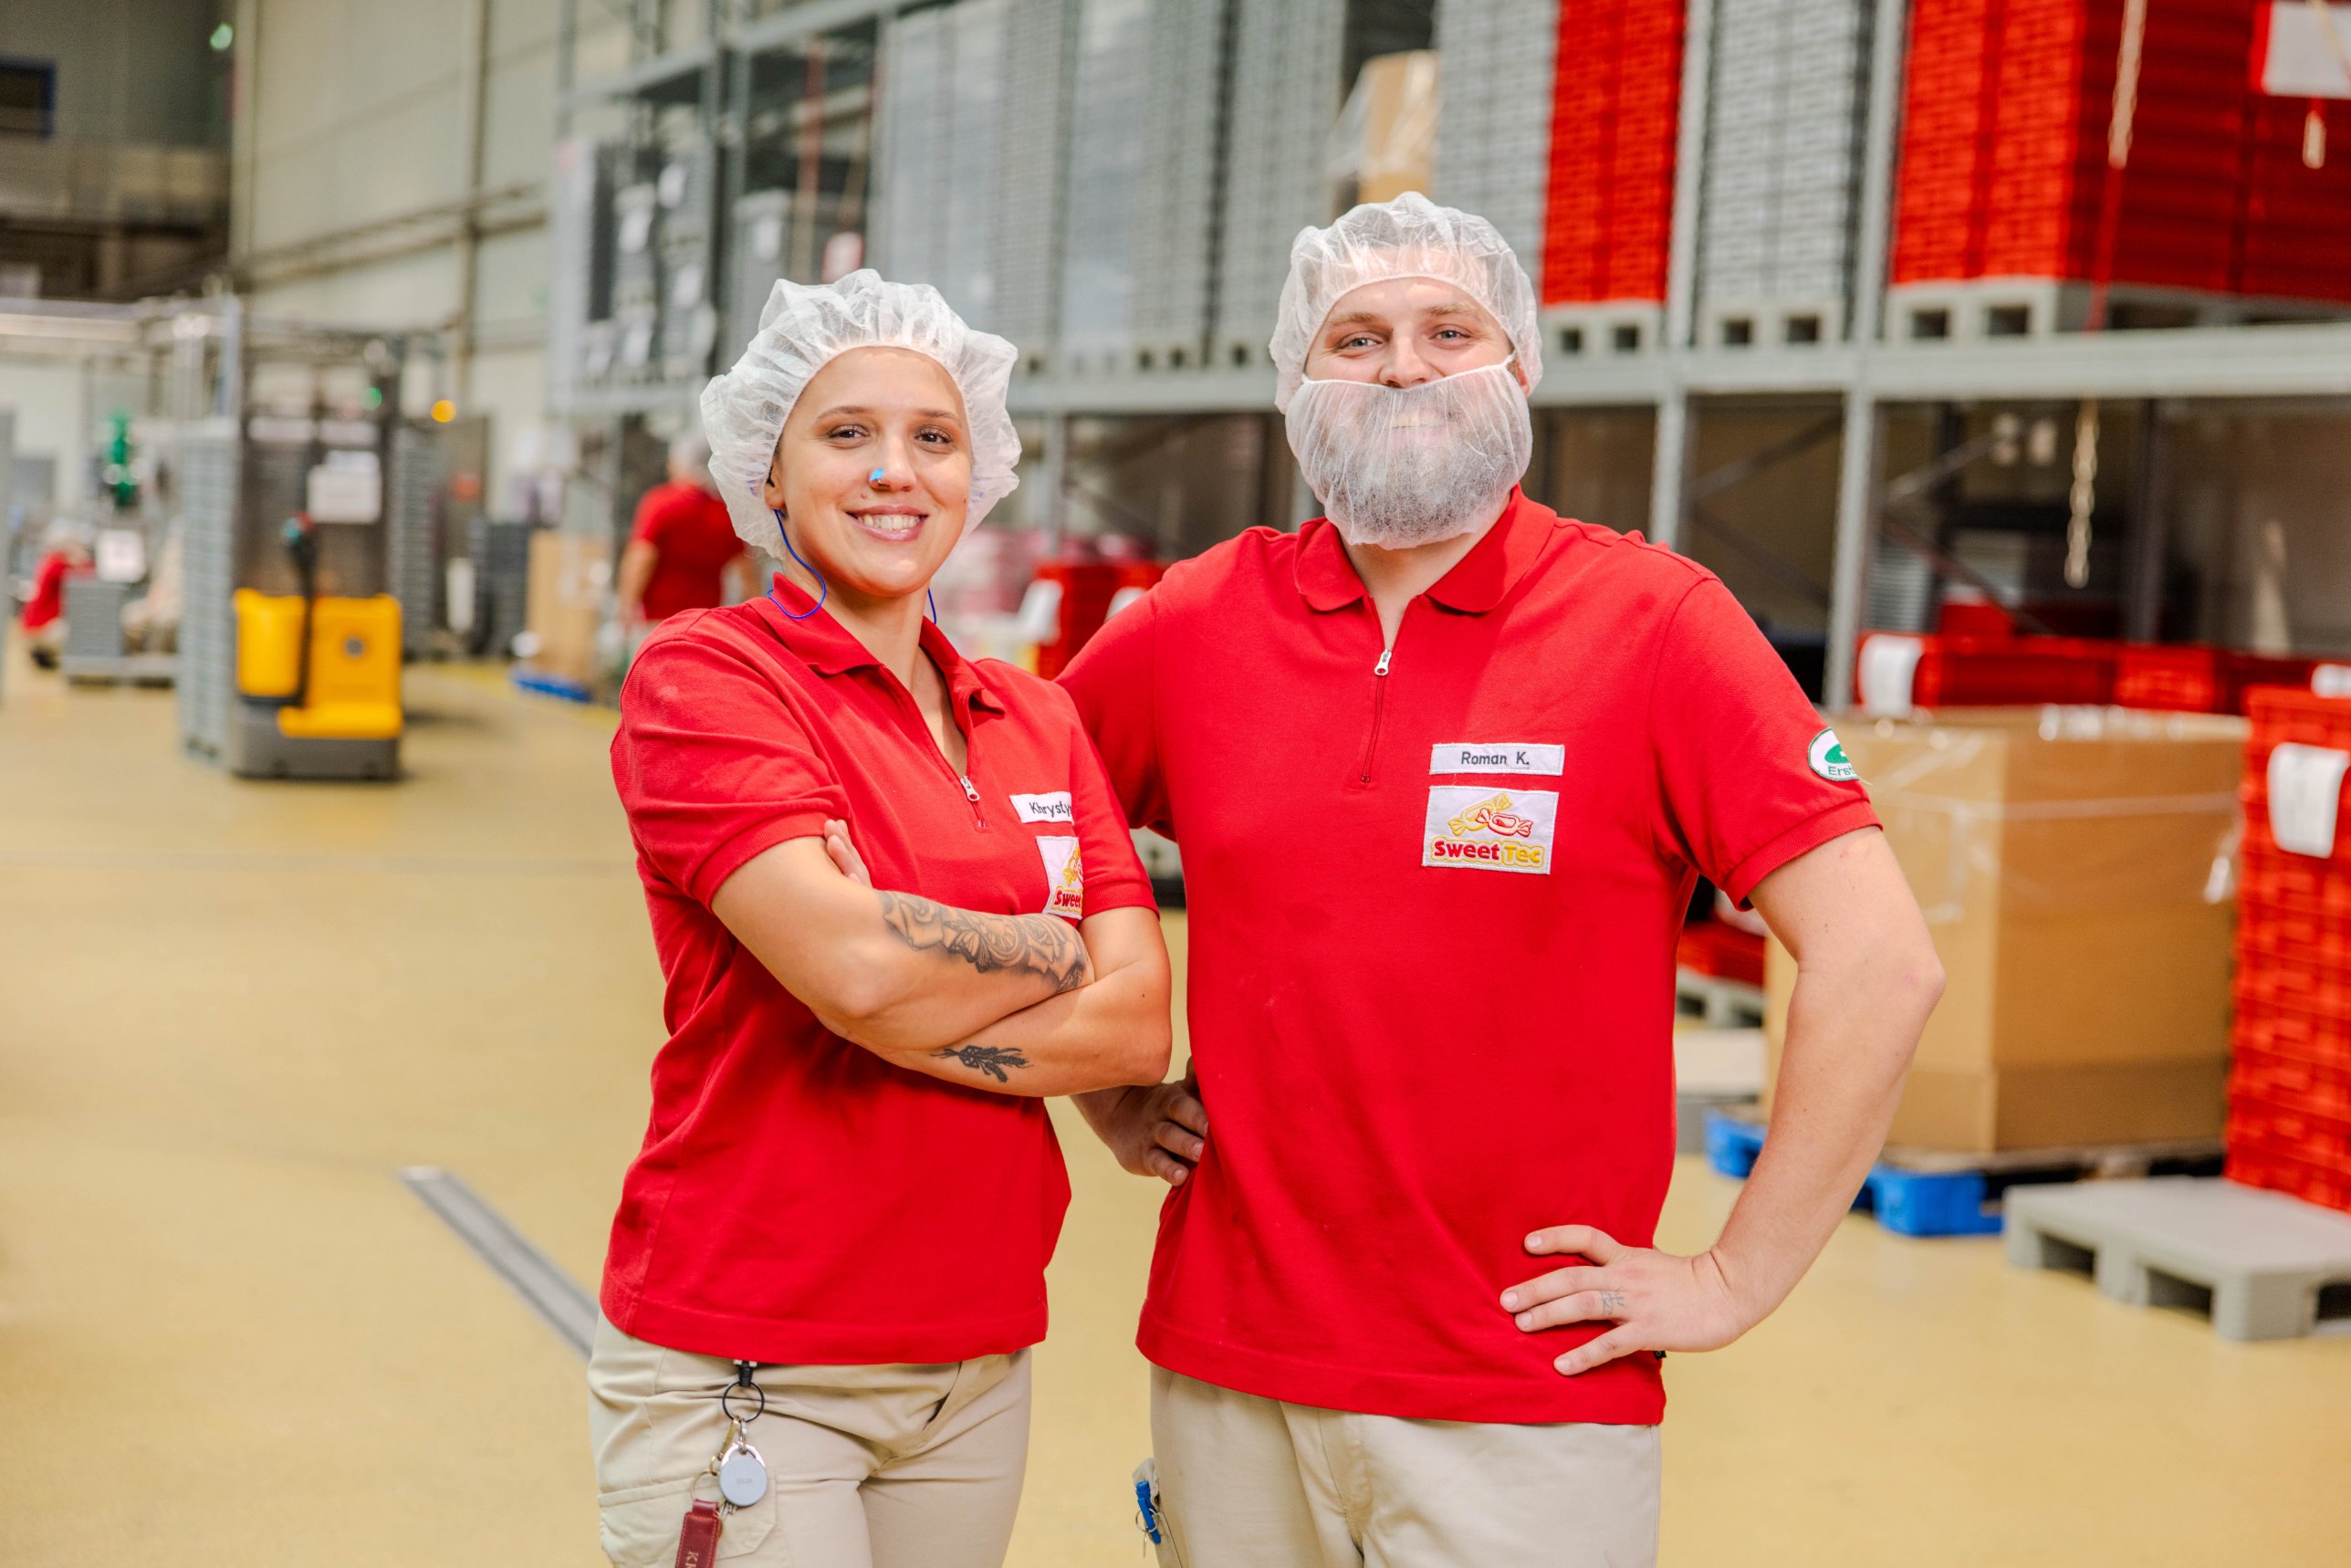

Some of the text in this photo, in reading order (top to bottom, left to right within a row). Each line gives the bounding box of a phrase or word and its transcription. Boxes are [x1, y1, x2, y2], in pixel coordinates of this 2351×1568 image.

[1461, 751, 1530, 765] Roman K.
[1029, 800, 1071, 818] Khrysty
[1434, 840, 1541, 864] Sweet Tec
